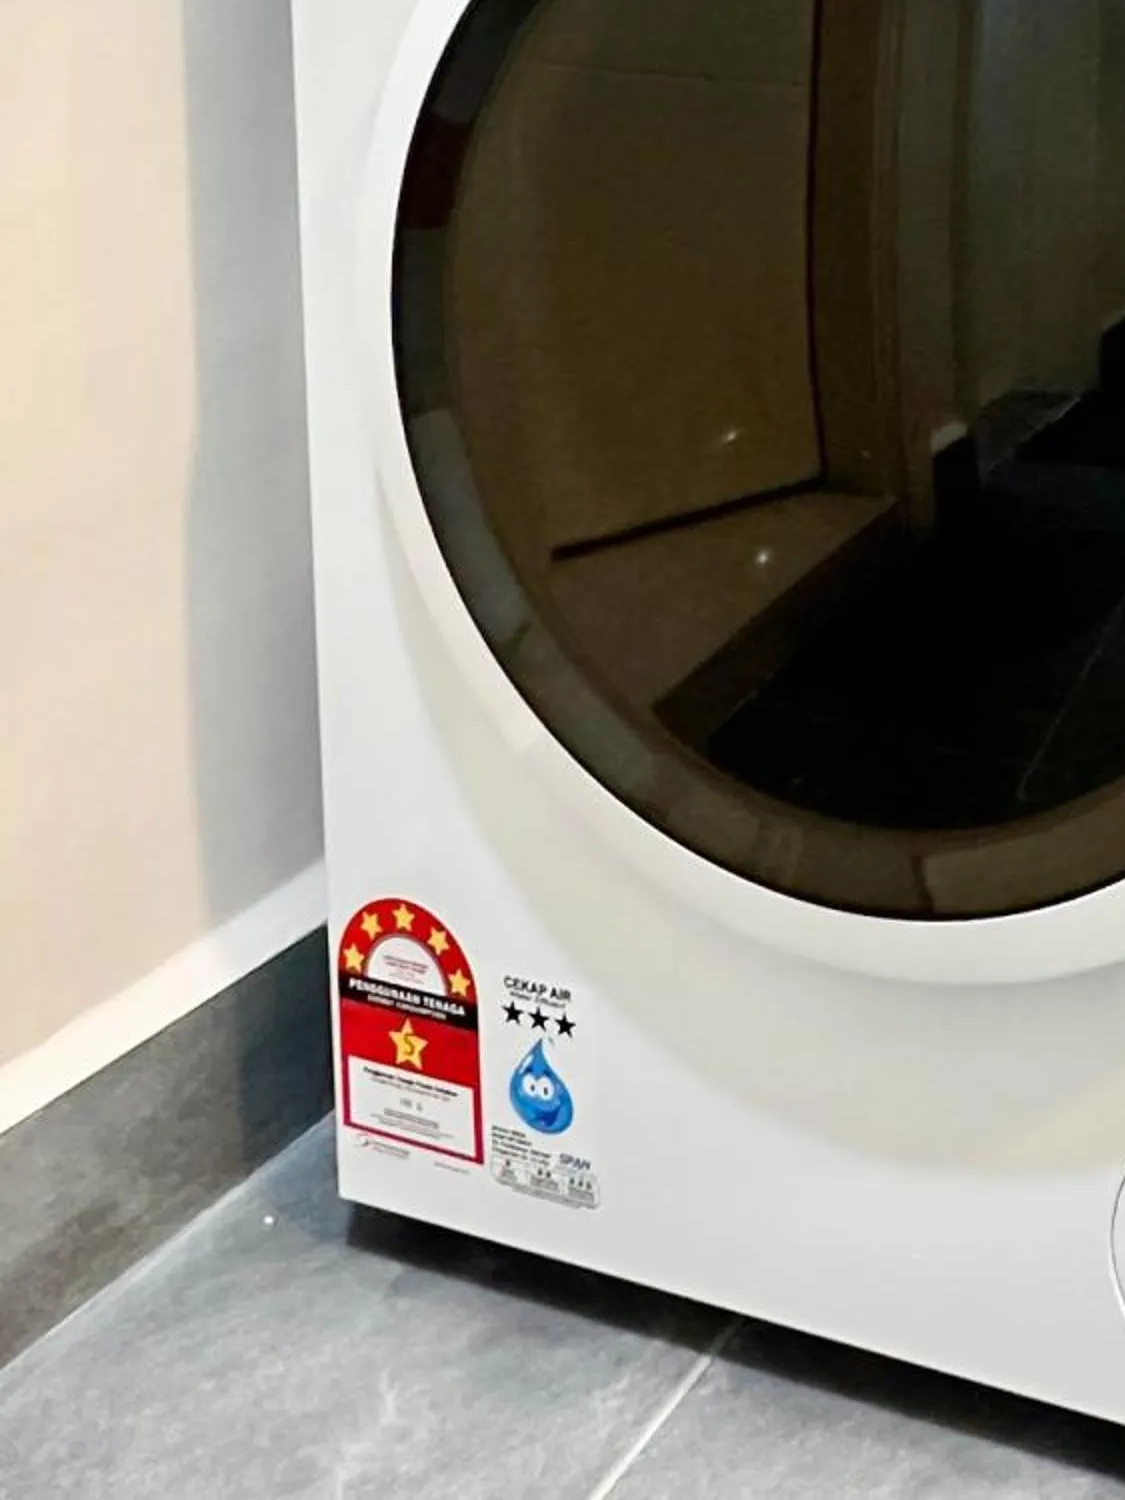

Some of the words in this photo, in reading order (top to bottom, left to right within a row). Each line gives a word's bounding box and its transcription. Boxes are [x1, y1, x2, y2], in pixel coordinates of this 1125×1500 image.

[349, 978, 421, 1004] PENGGUNAAN
[423, 996, 465, 1016] TENAGA
[504, 975, 547, 993] CEKAP
[550, 987, 571, 1001] AIR
